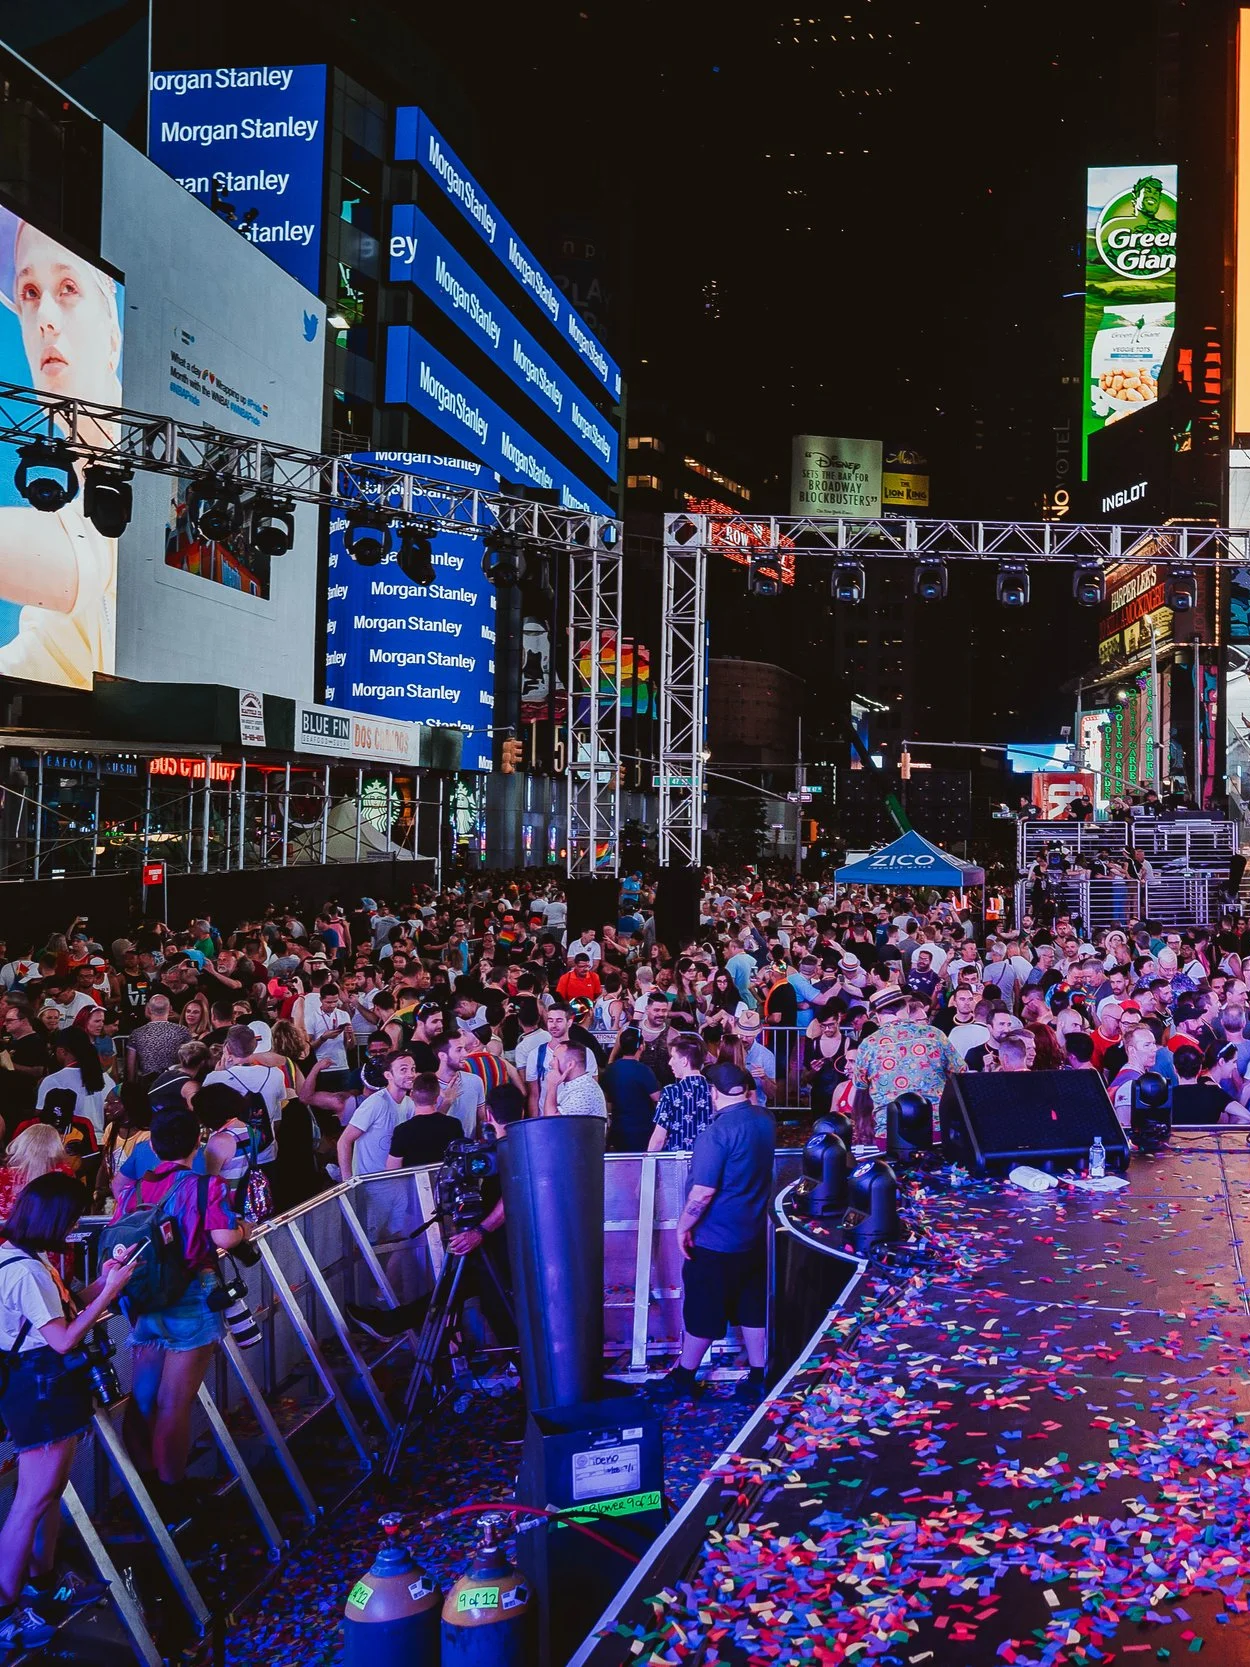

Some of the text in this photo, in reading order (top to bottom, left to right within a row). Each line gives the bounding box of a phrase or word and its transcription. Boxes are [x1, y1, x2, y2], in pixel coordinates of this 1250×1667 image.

[214, 66, 294, 91] Stanley
[161, 116, 319, 146] Morgan Stanley
[429, 135, 497, 244] Morgan Stanley
[509, 237, 560, 321] Morgan Stanley
[436, 256, 501, 348] Morgan Stanley
[568, 314, 609, 383] Morgan Stanley
[513, 339, 563, 413] Morgan Stanley
[420, 361, 489, 446] Morgan Stanley
[571, 402, 612, 463] Morgan Stanley
[501, 431, 530, 476] Morgan
[802, 469, 869, 482] SETS THE BAR FOR
[808, 480, 862, 493] BROADWAY
[884, 487, 928, 500] LION KING
[1102, 481, 1148, 513] INGLOT
[726, 526, 749, 546] ROW
[371, 581, 427, 600] Morgan
[428, 584, 478, 607] Stanley
[1111, 578, 1137, 613] HARPER
[353, 615, 462, 637] Morgan Stanley
[369, 649, 426, 667] Morgan
[427, 651, 476, 673] Stanley
[352, 683, 461, 703] Morgan Stanley
[302, 714, 349, 738] BLUE FIN
[355, 724, 371, 749] DOS
[1104, 726, 1112, 759] OLIVE
[1115, 713, 1124, 795] OLIVE GARDEN
[869, 854, 936, 867] ZICO
[626, 1497, 634, 1507] 9
[635, 1497, 647, 1507] of
[647, 1493, 660, 1505] 10
[459, 1592, 481, 1607] 9 of
